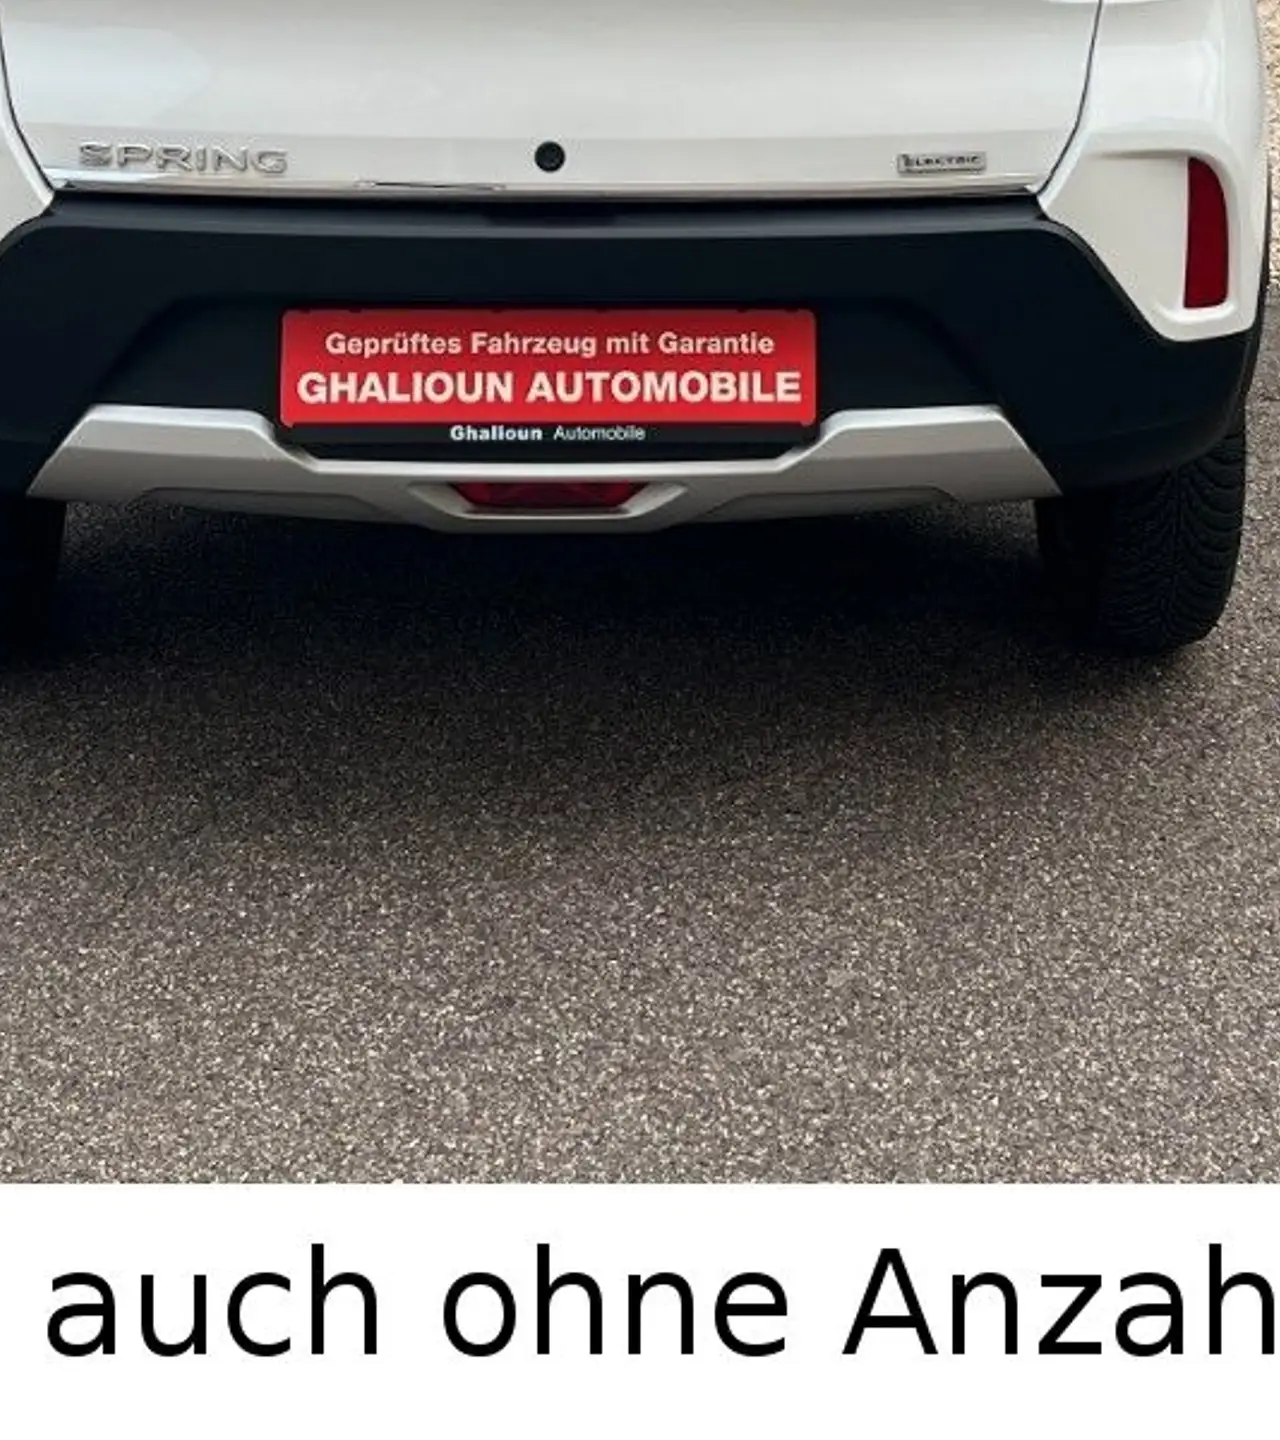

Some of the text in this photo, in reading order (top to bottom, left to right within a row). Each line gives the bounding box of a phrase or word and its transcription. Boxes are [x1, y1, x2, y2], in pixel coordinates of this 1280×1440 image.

[78, 140, 290, 175] SPRING
[324, 330, 776, 359] Geprüftes Fahrzeug mit Garantie
[296, 370, 803, 405] GHALIOUN AUTOMOBILE
[449, 424, 647, 442] Ghalioun Automobile
